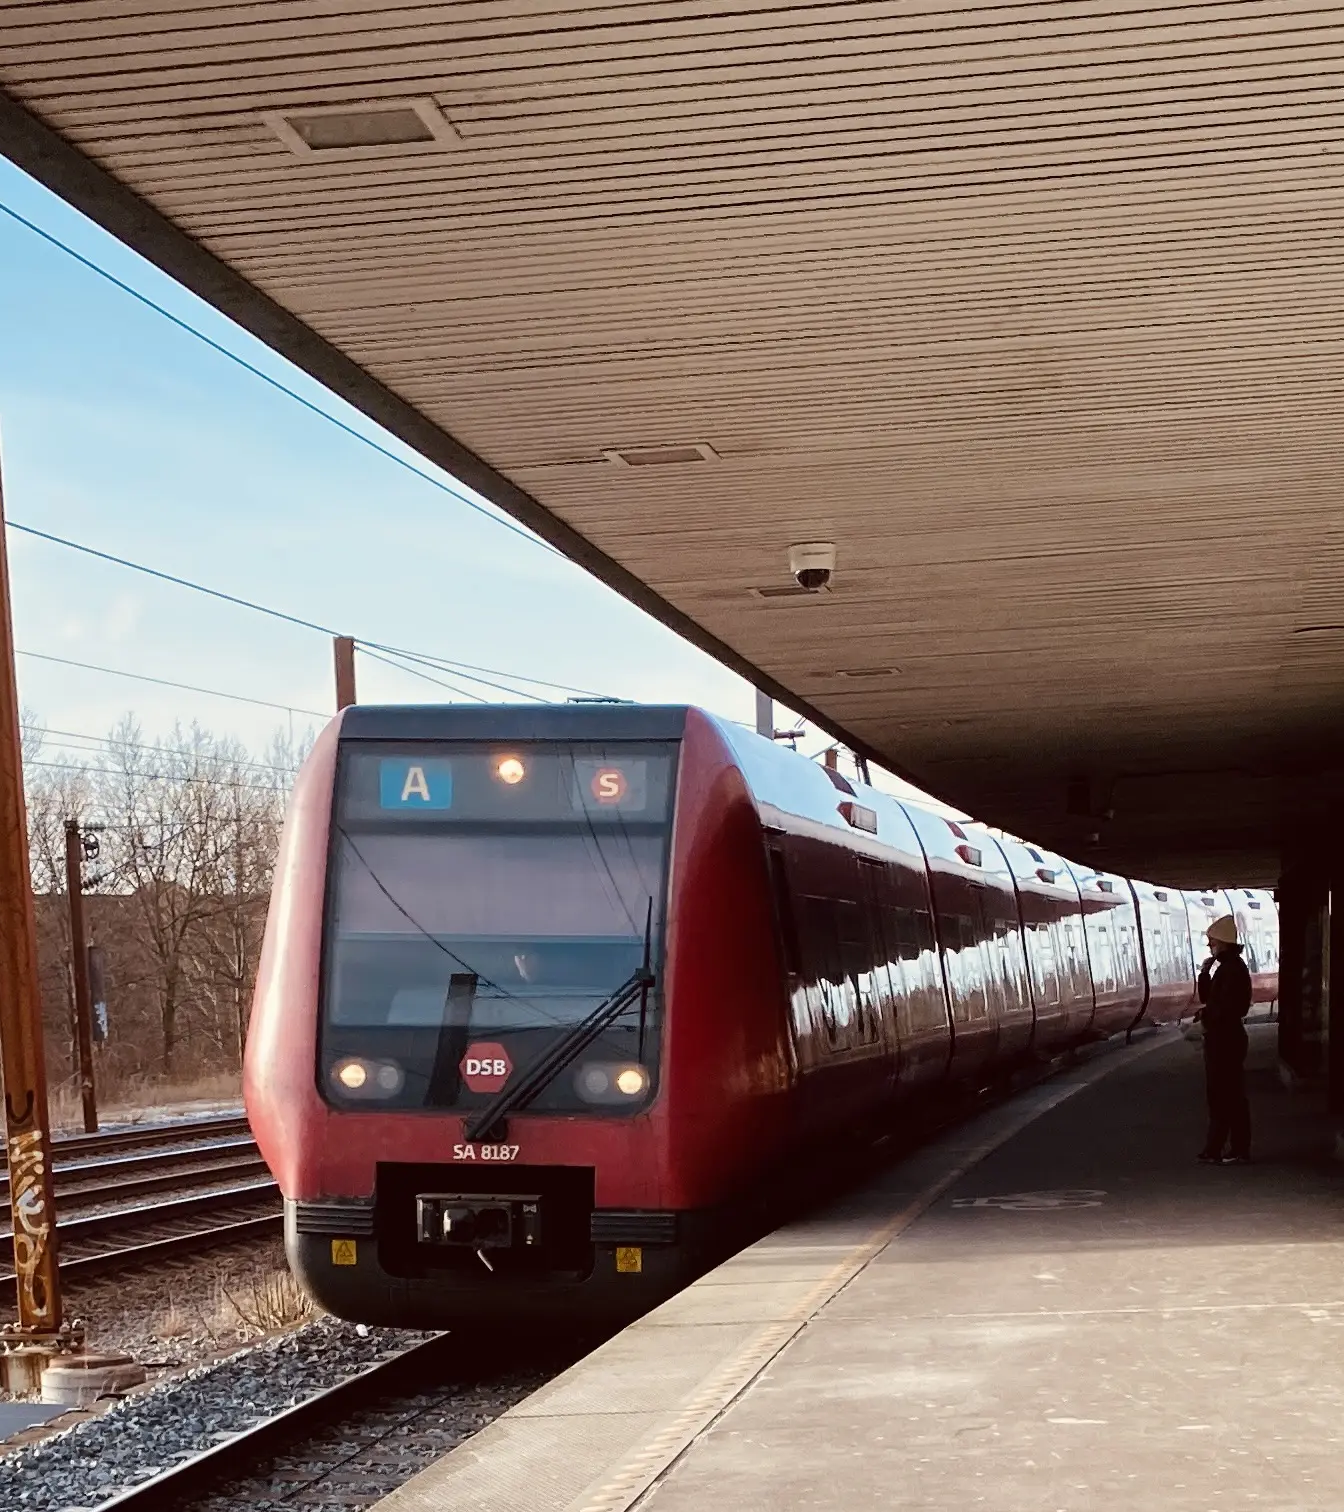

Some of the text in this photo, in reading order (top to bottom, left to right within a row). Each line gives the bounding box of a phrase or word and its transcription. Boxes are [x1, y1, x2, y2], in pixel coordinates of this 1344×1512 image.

[401, 767, 431, 801] A
[598, 773, 619, 797] S
[466, 1059, 507, 1076] DSB
[453, 1144, 520, 1161] SA 8187
